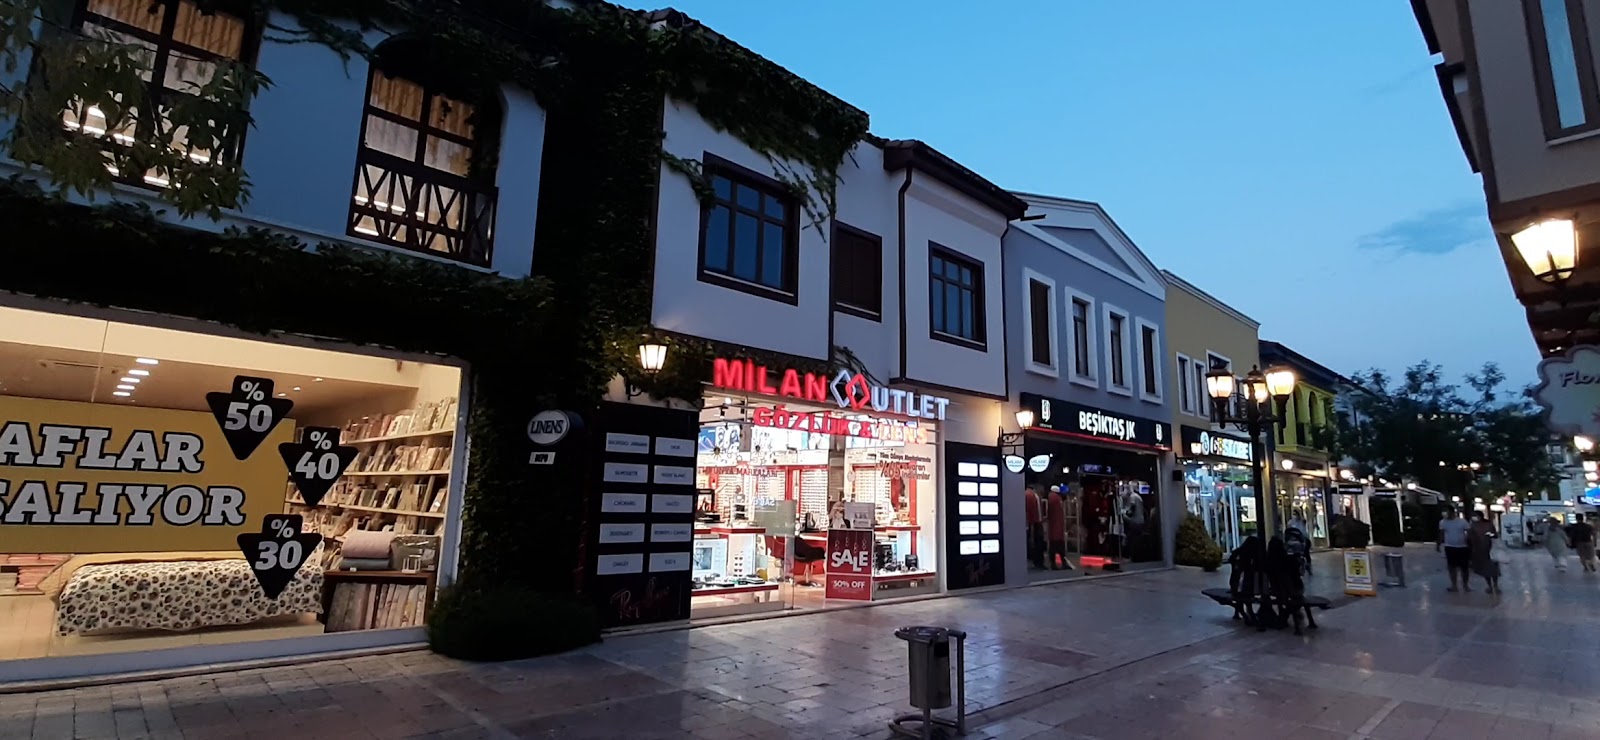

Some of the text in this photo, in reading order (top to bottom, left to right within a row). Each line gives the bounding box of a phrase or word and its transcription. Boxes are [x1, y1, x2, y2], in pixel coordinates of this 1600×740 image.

[224, 402, 273, 432] 50
[530, 420, 564, 434] LINENS
[753, 404, 850, 437] GÖZLÜK
[1078, 411, 1136, 441] BEŞİKTAŞ JK
[295, 451, 340, 480] 40
[254, 540, 303, 570] 30
[831, 548, 869, 572] SALE
